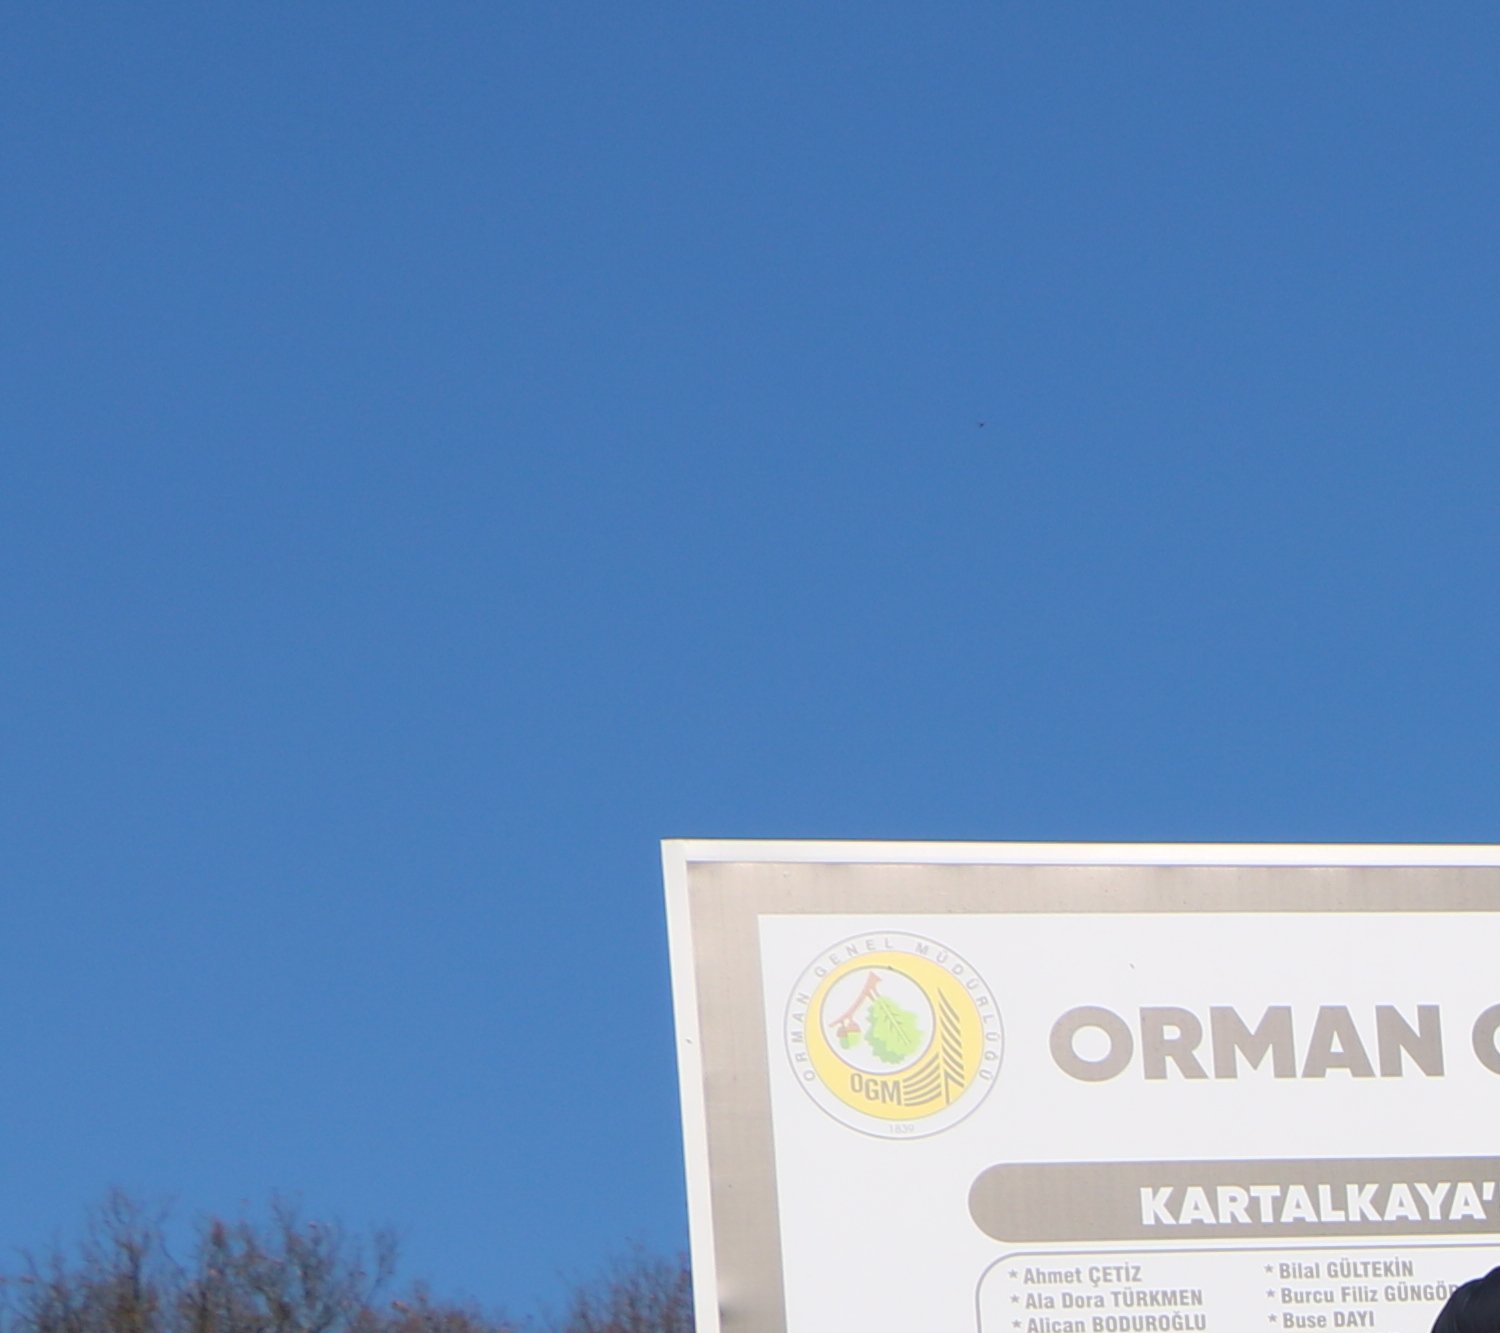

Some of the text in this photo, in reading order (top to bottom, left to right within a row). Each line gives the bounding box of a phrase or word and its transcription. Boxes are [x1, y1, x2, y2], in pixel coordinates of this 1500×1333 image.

[791, 993, 816, 1082] ORMAN
[814, 938, 894, 979] GENEL
[1049, 1005, 1445, 1082] ORMAN
[850, 1073, 902, 1106] OGM
[1024, 1262, 1142, 1287] Ahmet ÇETİZ
[1279, 1257, 1413, 1279] Bilal GÜLTEKİN
[1025, 1287, 1203, 1309] Ala Dora TÜRKMEN
[1281, 1287, 1334, 1304] Burcu
[1341, 1286, 1378, 1303] Filiz
[1027, 1311, 1206, 1333] Alican BODUROĞLU
[1283, 1311, 1374, 1328] Buse DAYI
